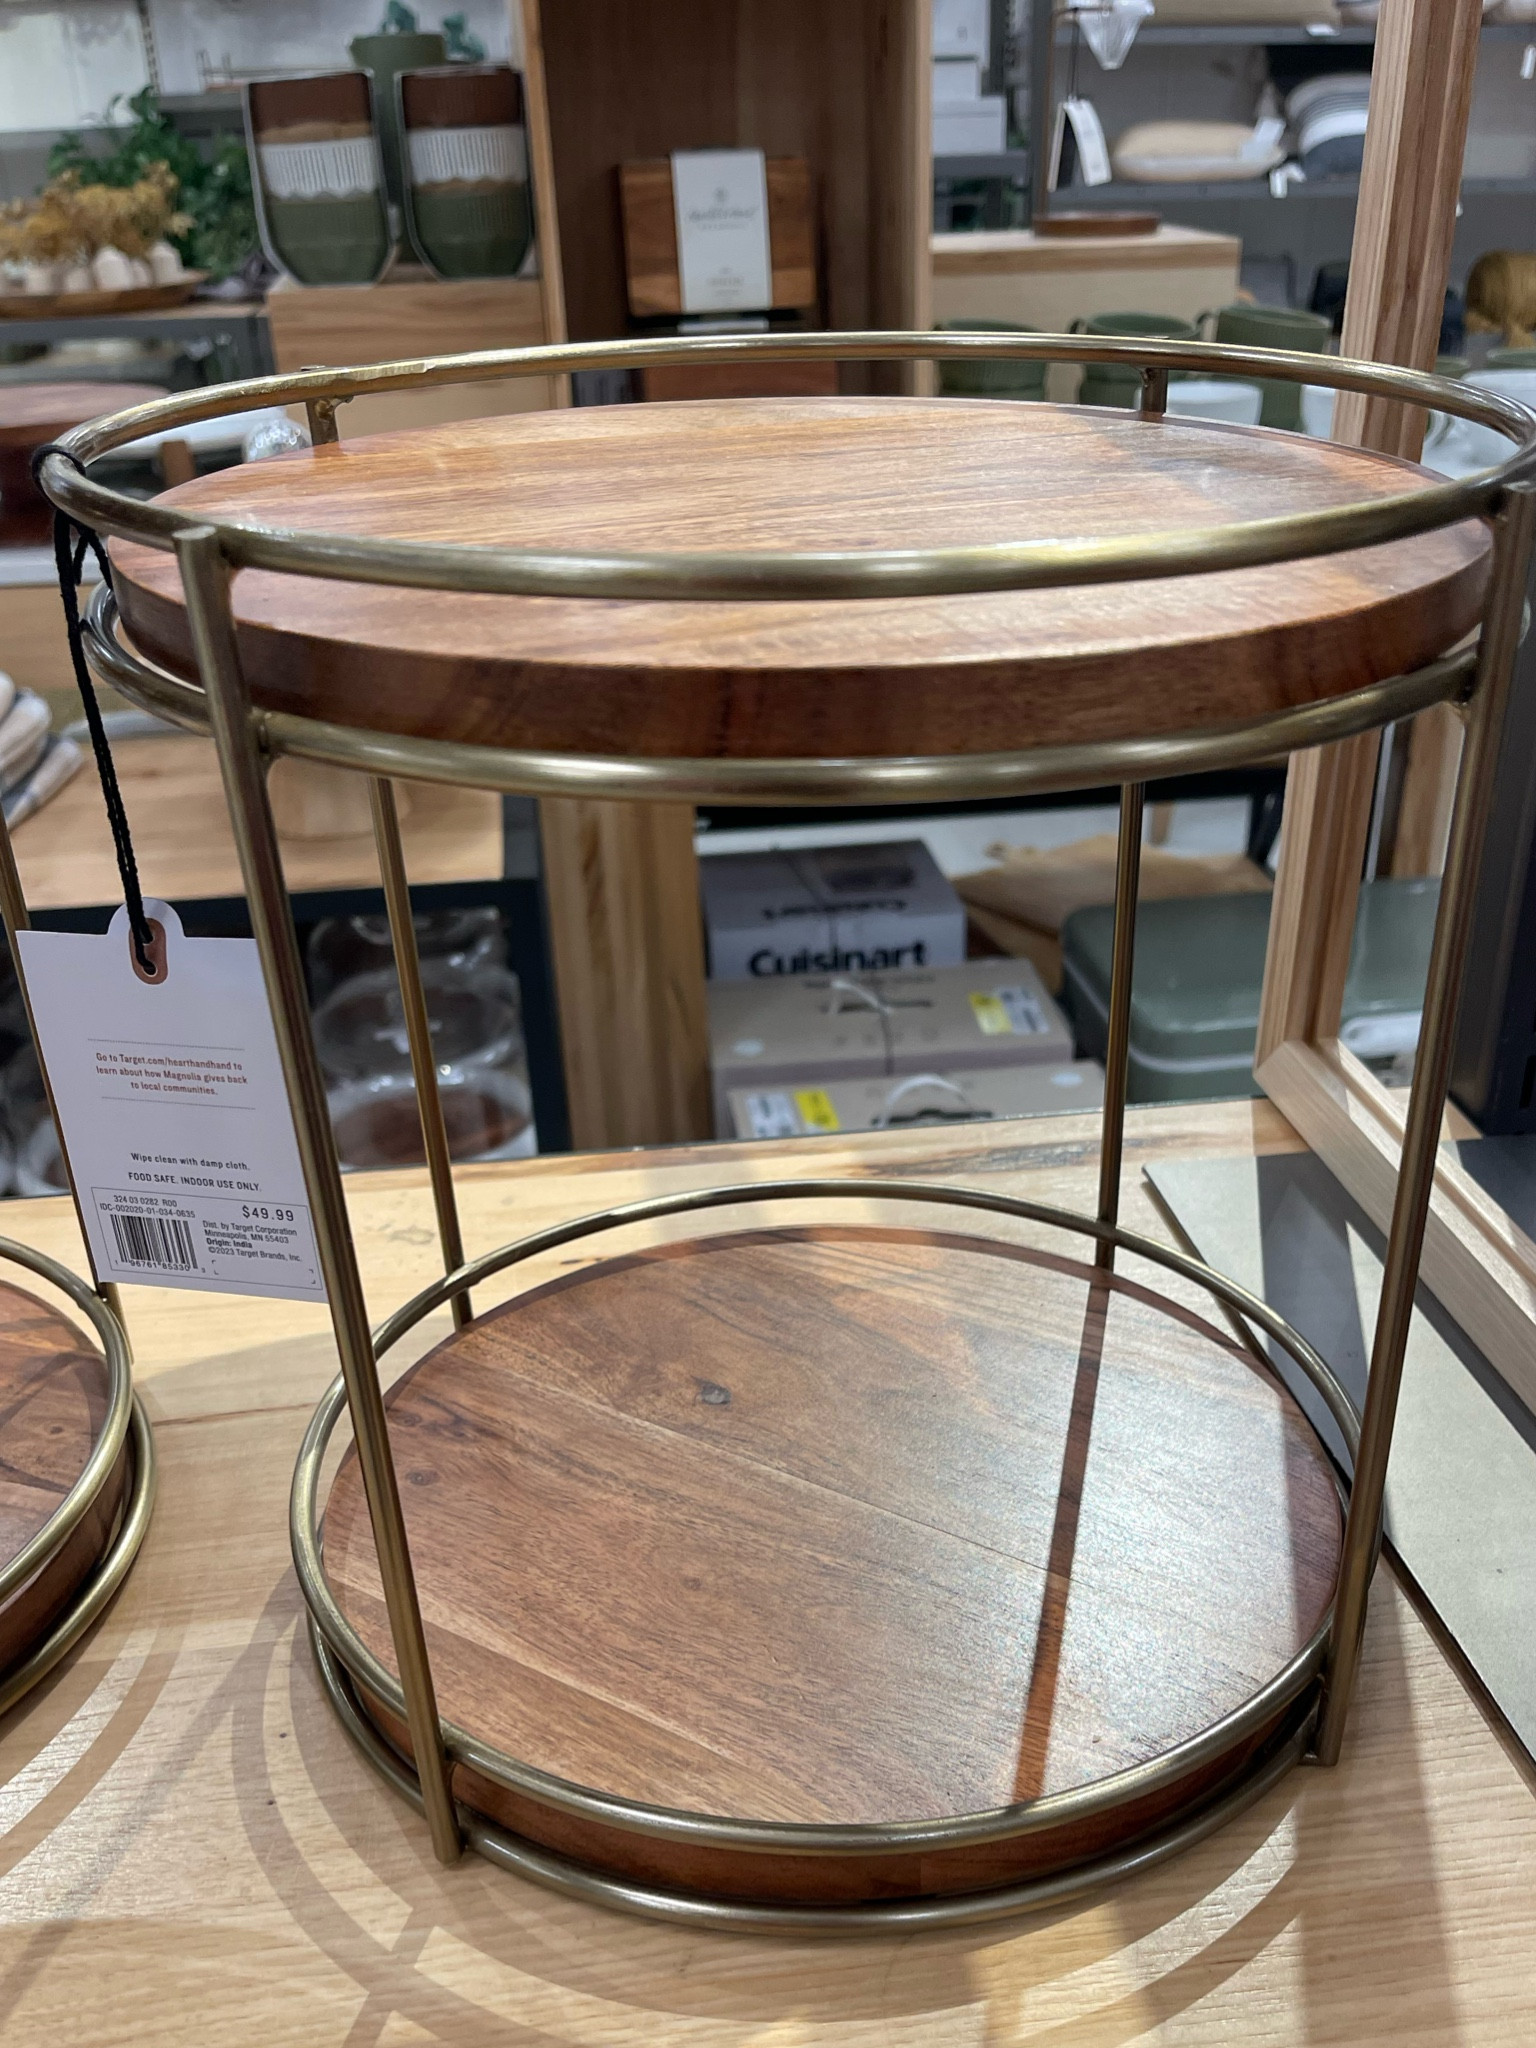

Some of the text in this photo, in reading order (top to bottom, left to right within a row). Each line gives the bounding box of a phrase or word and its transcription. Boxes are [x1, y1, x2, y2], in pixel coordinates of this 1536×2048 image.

[749, 939, 926, 977] Cuisinart
[96, 1052, 243, 1071] Go to Target.com/hearthandhand to
[96, 1066, 248, 1085] learn about how Magnolia gives back
[130, 1081, 219, 1095] to local communities.
[130, 1152, 251, 1171] Wipe clean with damp cloth.
[128, 1172, 262, 1192] FOOD SAFE. INDOOR USE ONLY.
[113, 1195, 127, 1204] 324
[129, 1196, 139, 1204] 03
[140, 1197, 159, 1206] 0282
[242, 1204, 294, 1221] $49.99
[202, 1220, 298, 1236] Dist. by Target Corporation
[204, 1229, 290, 1244] Minneapolis, MN 55403
[206, 1237, 253, 1248] Origin: India
[208, 1246, 302, 1262] ©2023 Target Brands, Inc.
